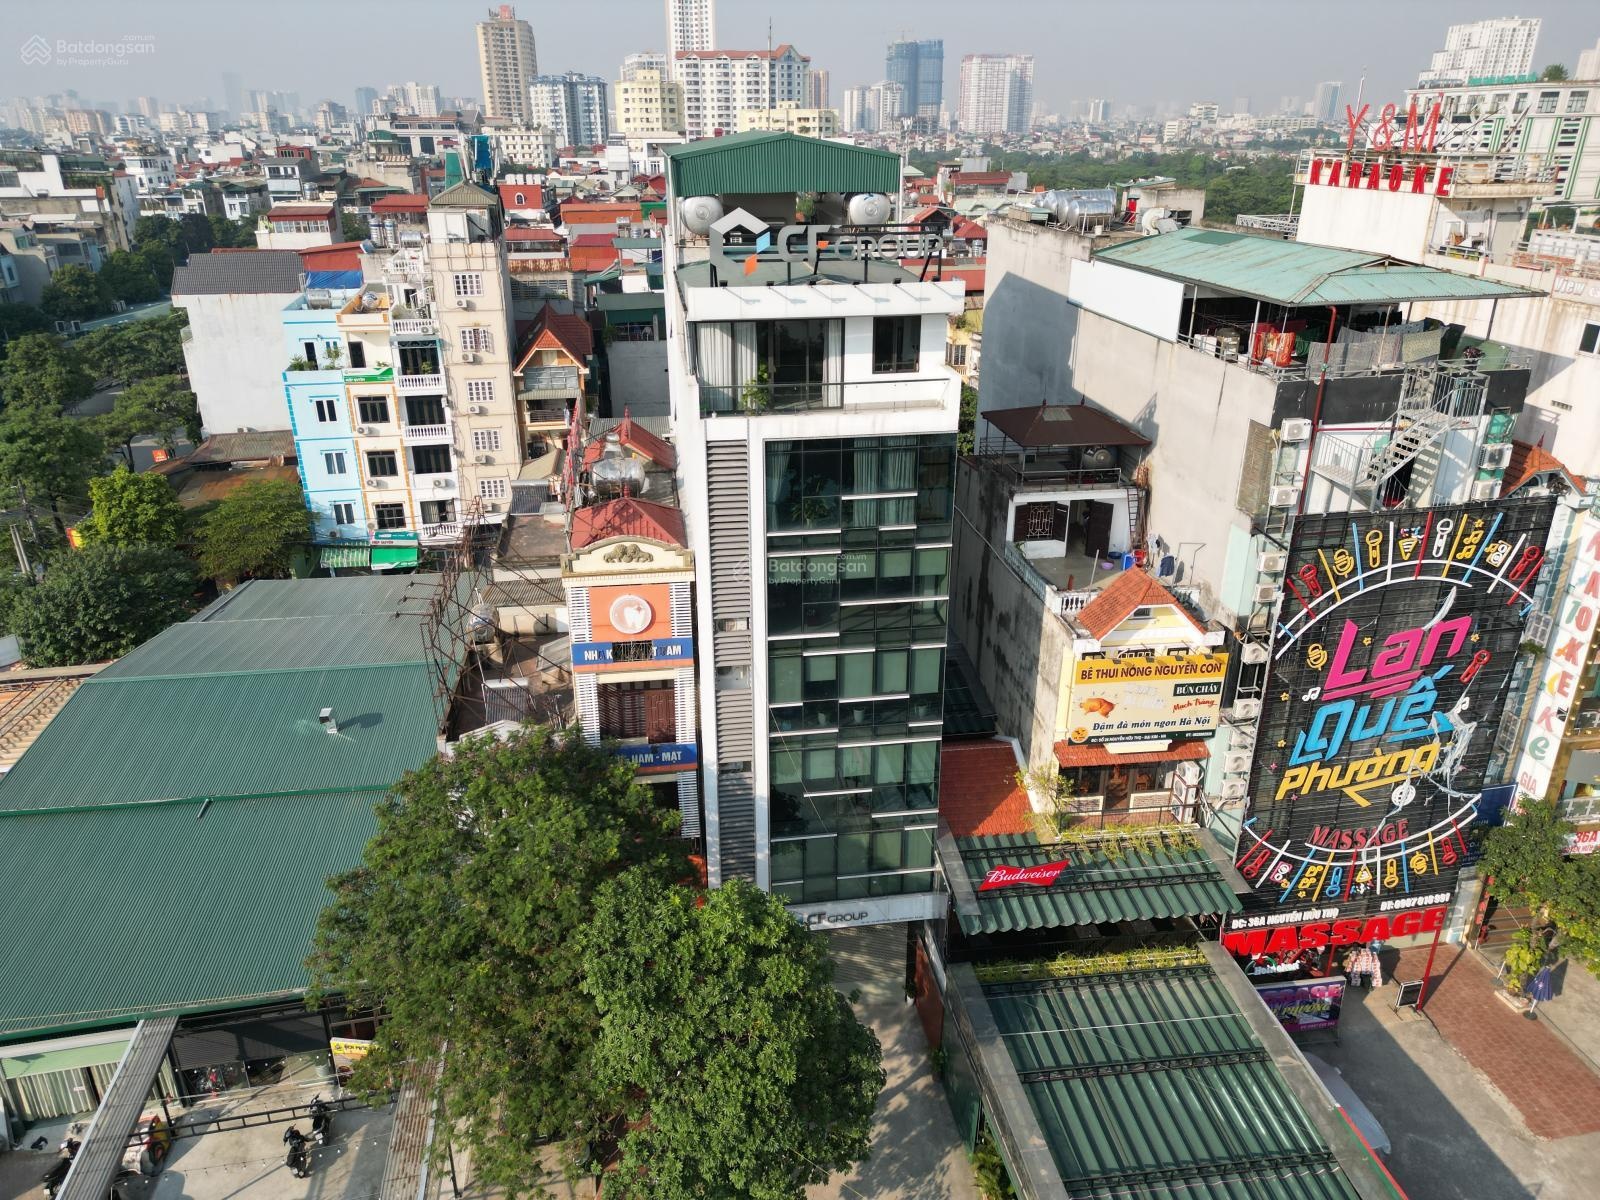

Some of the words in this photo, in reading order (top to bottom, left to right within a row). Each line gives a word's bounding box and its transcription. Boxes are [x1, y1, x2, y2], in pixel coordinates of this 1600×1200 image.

[1346, 102, 1442, 153] Y&M
[1310, 158, 1454, 196] KARAOKE
[834, 233, 944, 261] GROUP
[1323, 615, 1472, 690] Lan
[1081, 666, 1093, 680] BÊ
[1095, 667, 1119, 679] THUI
[1120, 663, 1152, 678] NÓNG
[1154, 661, 1198, 676] NGUYÊN
[1200, 662, 1222, 674] CON
[1176, 684, 1195, 695] BÚN
[1092, 722, 1114, 733] Đậm
[1117, 720, 1128, 729] đà
[1131, 719, 1151, 728] món
[1154, 720, 1176, 729] ngon
[1179, 717, 1191, 726] Hà
[1194, 716, 1211, 727] Nội
[1288, 664, 1456, 766] Quế
[1520, 771, 1537, 795] GIA
[1308, 818, 1409, 849] MASSAGE
[986, 868, 1061, 883] Budweiser
[827, 911, 869, 924] GROUP
[1223, 905, 1448, 957] MASSAGE
